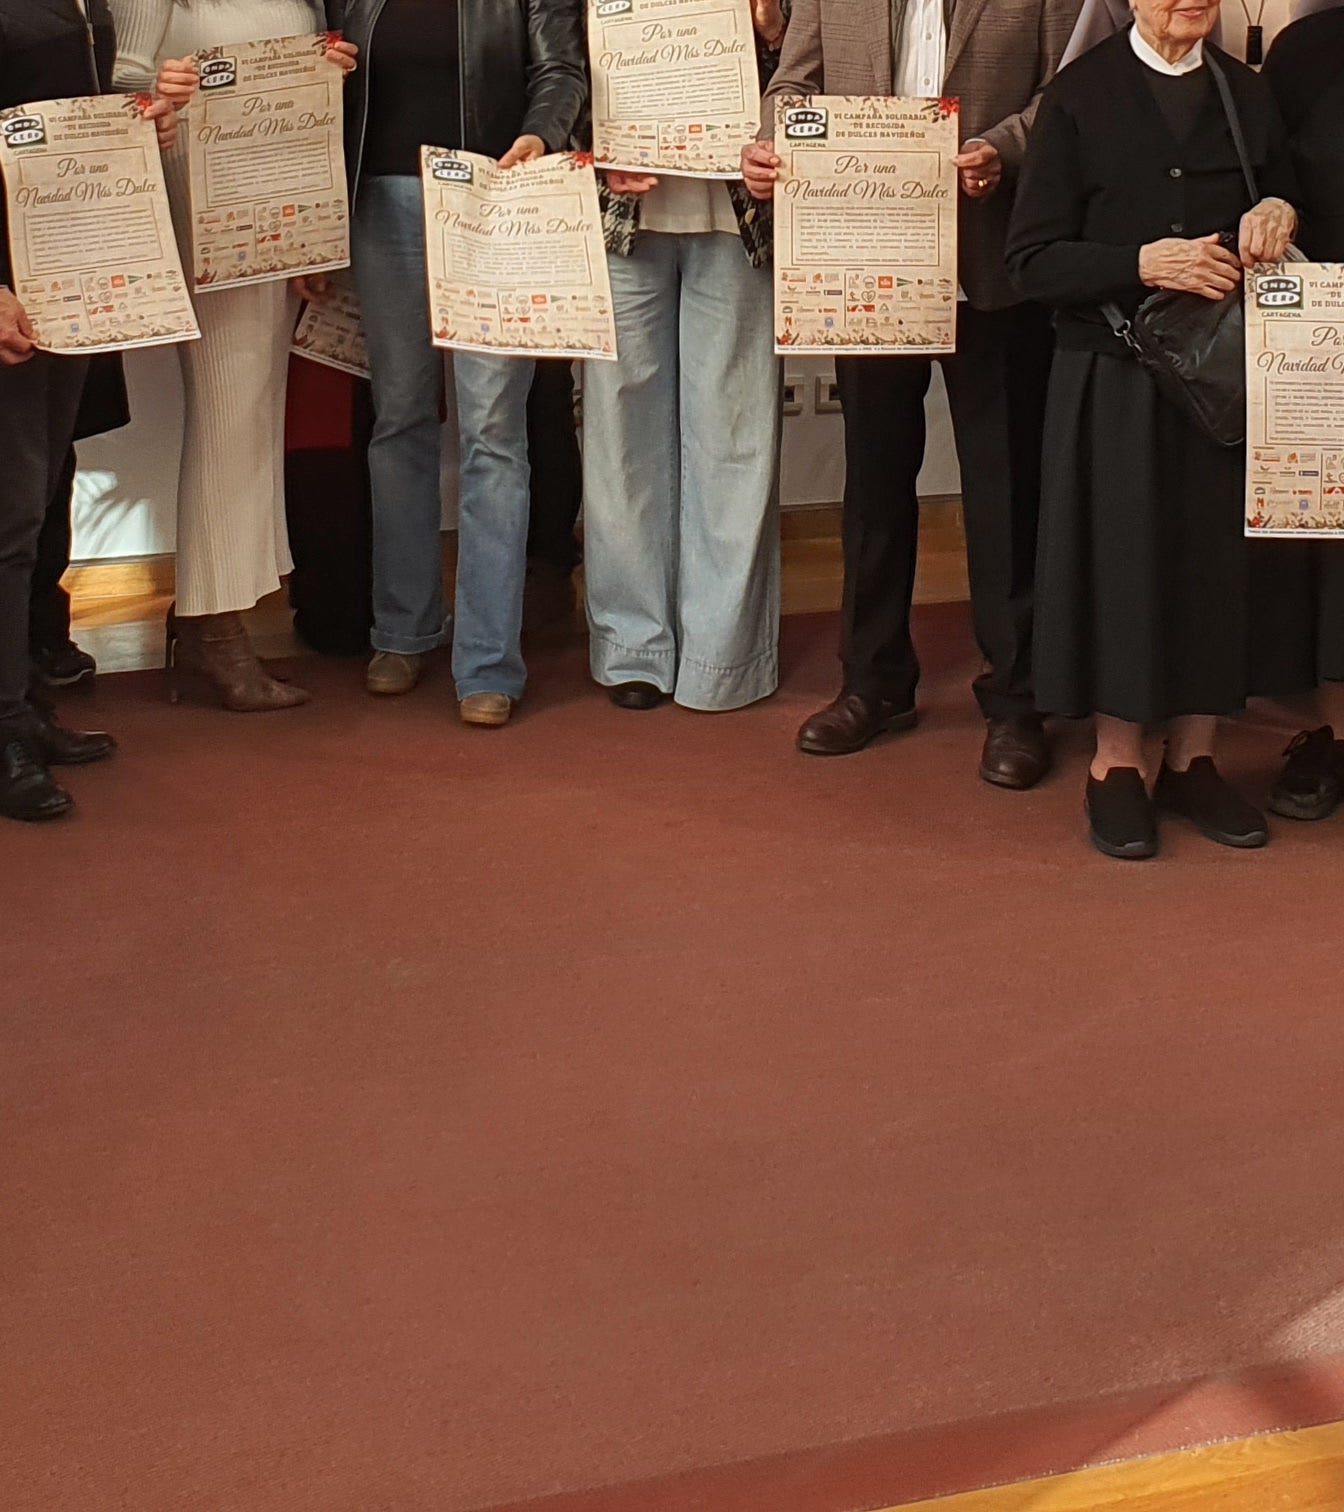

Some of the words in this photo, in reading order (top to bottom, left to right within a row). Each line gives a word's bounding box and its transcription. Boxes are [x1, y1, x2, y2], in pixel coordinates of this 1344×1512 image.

[642, 24, 672, 42] Por
[677, 26, 697, 37] una
[599, 50, 659, 70] Navidad
[704, 39, 745, 57] Dulce
[835, 155, 868, 174] Por
[873, 163, 896, 173] una
[784, 179, 852, 200] Navidad
[853, 180, 895, 200] Más
[900, 181, 948, 200] Dulce
[1257, 351, 1330, 375] Navidad
